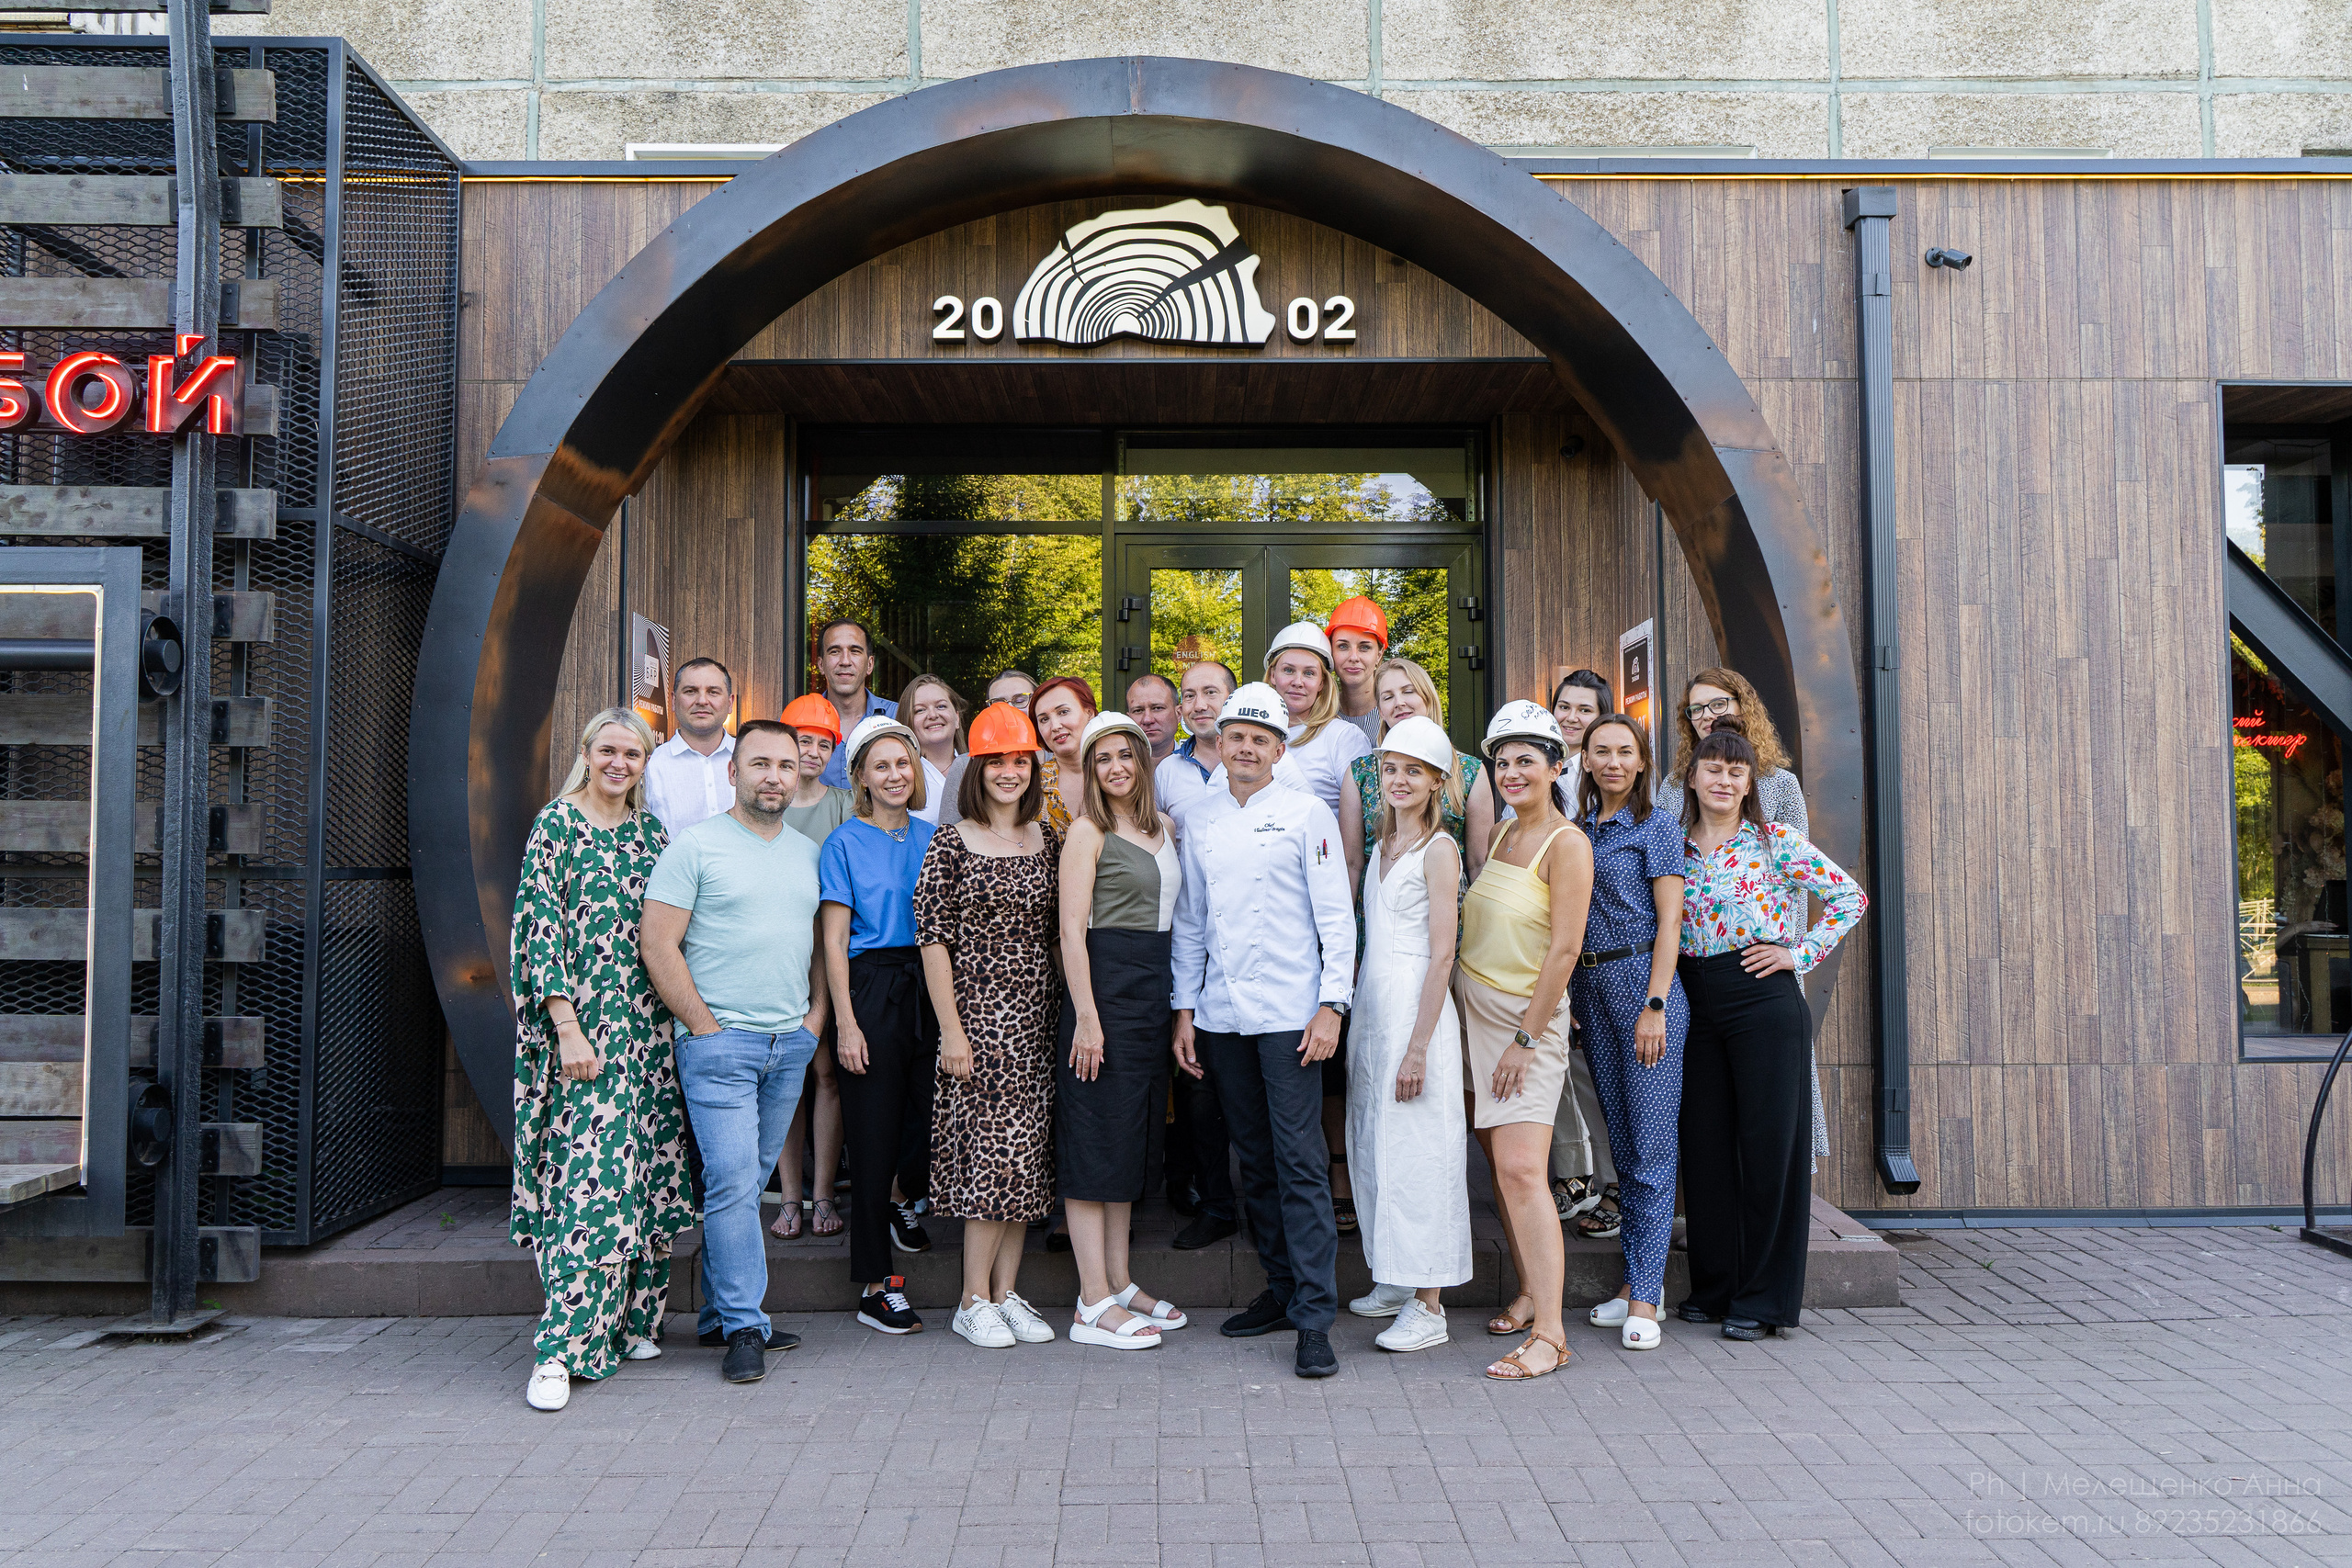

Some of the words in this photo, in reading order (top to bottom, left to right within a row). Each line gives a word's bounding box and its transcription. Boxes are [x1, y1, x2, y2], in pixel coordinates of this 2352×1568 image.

[932, 294, 1004, 342] 20
[1286, 294, 1357, 341] 02
[1175, 650, 1216, 659] ENGLISH
[1238, 706, 1270, 719] ШЕФ
